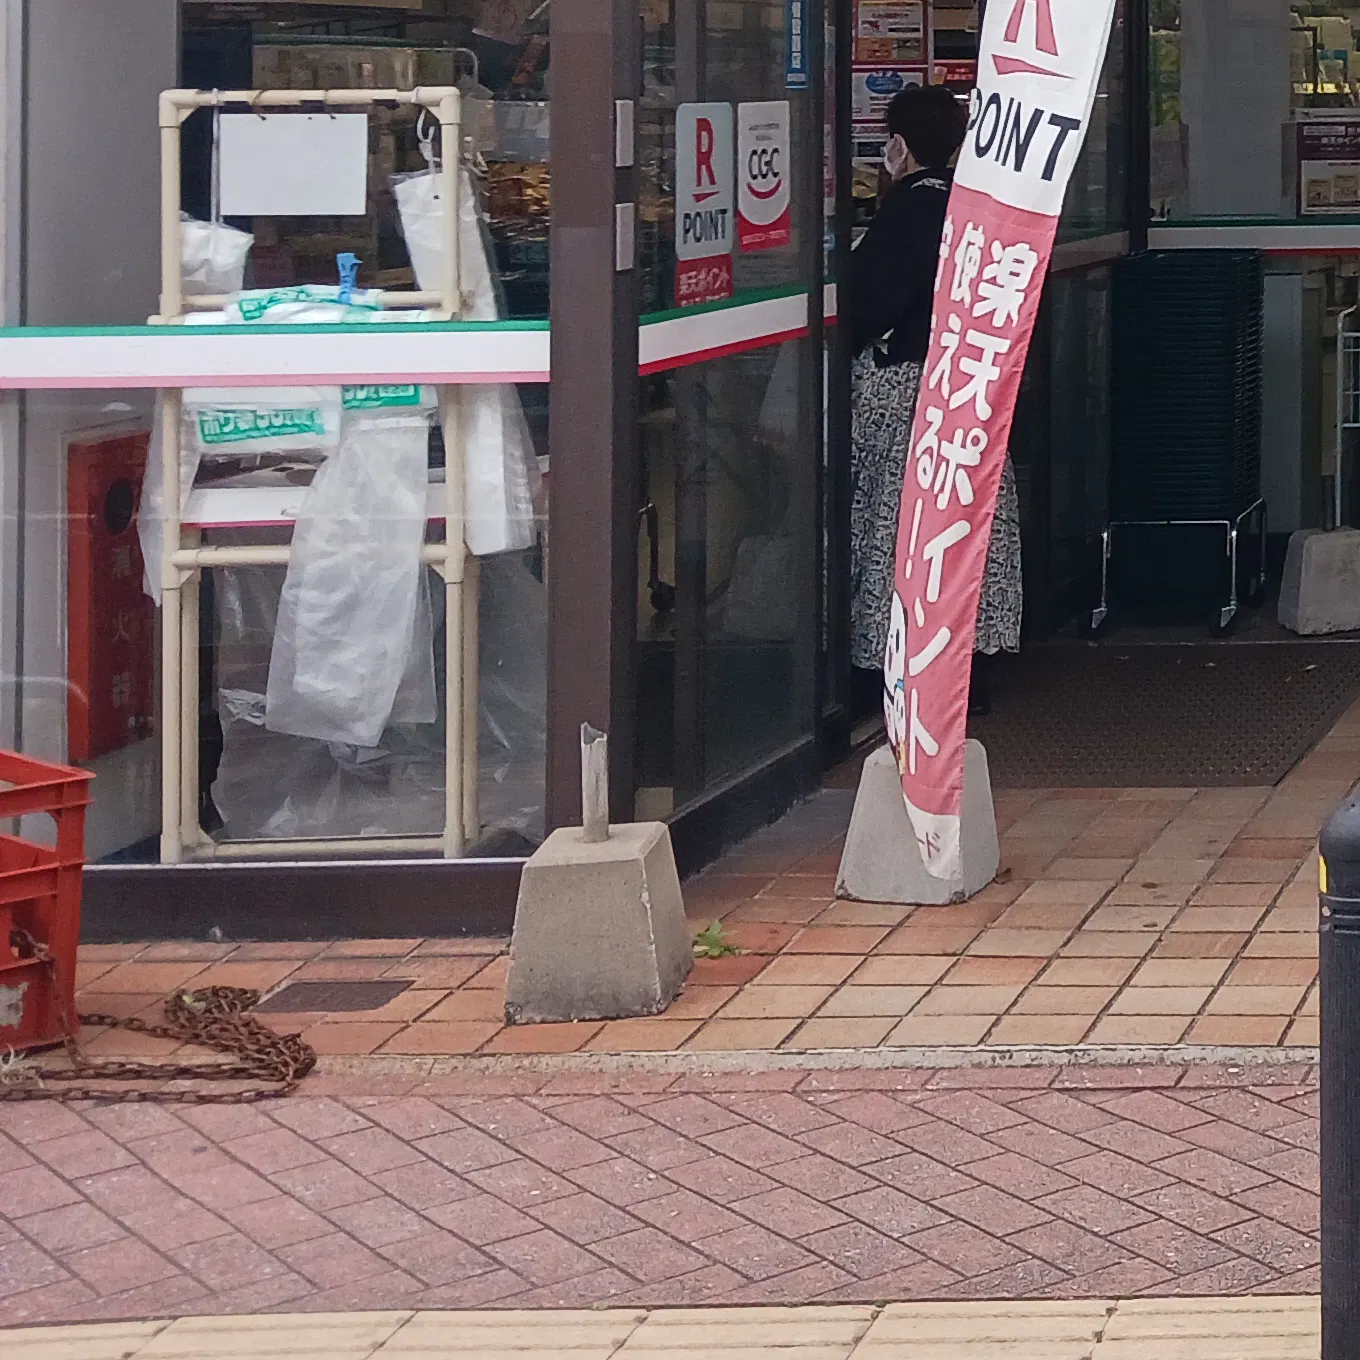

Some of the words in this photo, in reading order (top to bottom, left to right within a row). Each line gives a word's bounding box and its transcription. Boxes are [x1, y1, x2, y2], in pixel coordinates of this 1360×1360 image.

[695, 117, 717, 188] R
[747, 147, 781, 181] CGC
[682, 208, 729, 245] POINT
